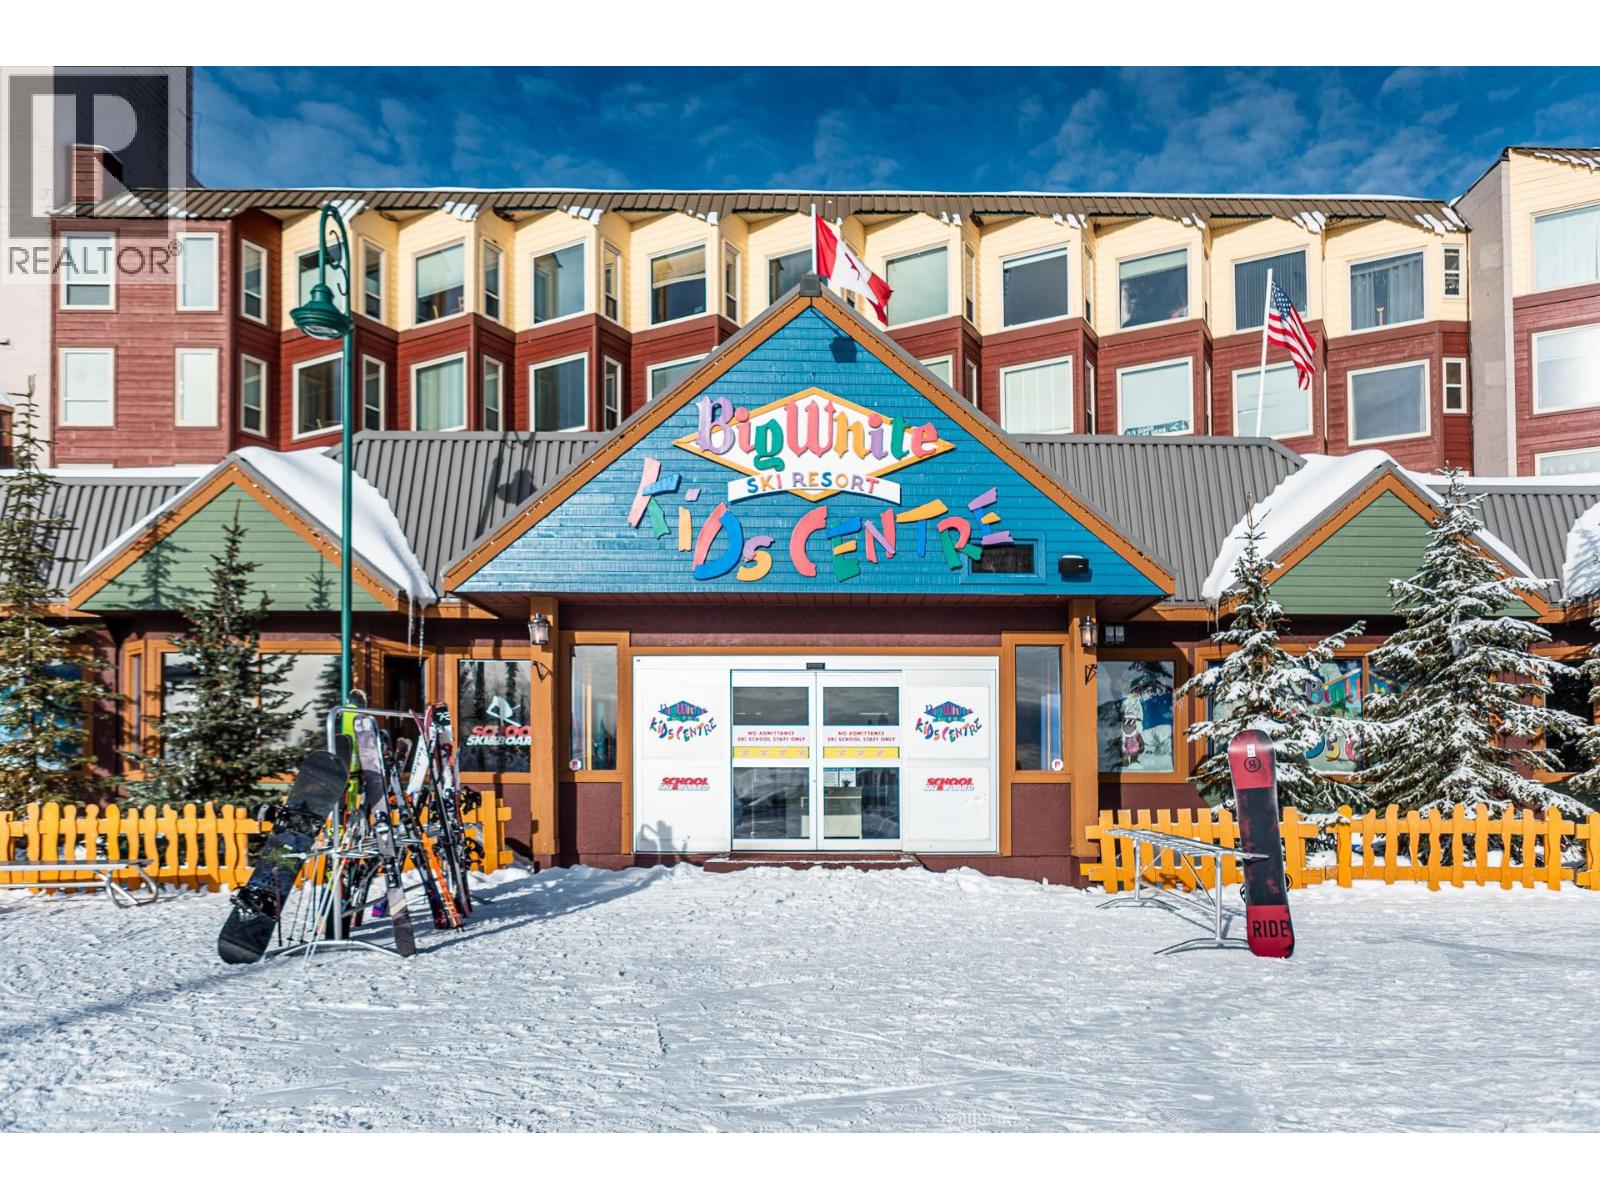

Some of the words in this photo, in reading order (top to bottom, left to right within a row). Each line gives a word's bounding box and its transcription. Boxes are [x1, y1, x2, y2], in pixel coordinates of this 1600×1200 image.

[747, 473, 783, 492] SKI
[791, 471, 880, 493] RESORT
[662, 777, 708, 786] SCHOOL
[927, 777, 973, 786] SCHOOL
[1252, 920, 1288, 938] RIDE
